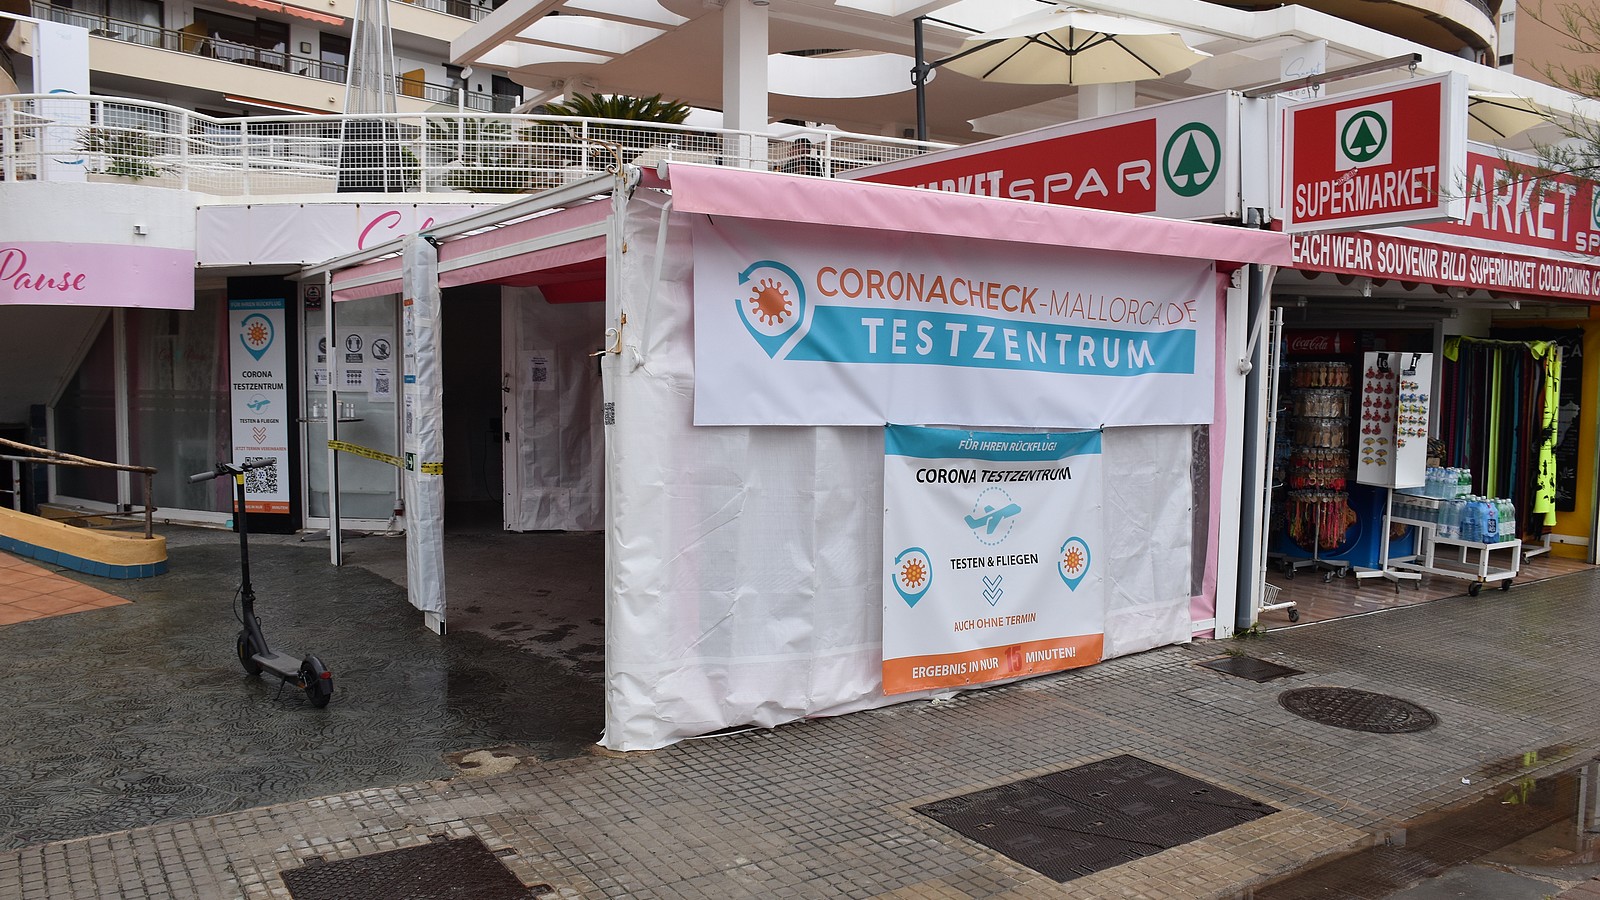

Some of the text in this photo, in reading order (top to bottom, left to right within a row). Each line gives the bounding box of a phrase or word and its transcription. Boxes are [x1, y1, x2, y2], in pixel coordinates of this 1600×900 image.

[1008, 159, 1151, 203] SPAR
[1295, 165, 1436, 219] SUPERMARKET
[1463, 164, 1577, 242] ARKET
[1575, 231, 1600, 252] SP
[0, 248, 86, 291] Pause
[1291, 234, 1330, 266] EACH
[1332, 236, 1373, 270] WEAR
[1377, 241, 1438, 279] SOUVENIR
[1441, 251, 1466, 282] BILD
[1469, 255, 1536, 289] SUPERMARKET
[816, 266, 1197, 326] CORONACHECK-MALLORCA.DE
[861, 317, 1156, 370] TESTZENTRUM
[233, 383, 284, 391] TESTZENTRUM
[242, 370, 273, 378] CORONA
[958, 438, 1057, 452] FÜR IHREN RÜCKFLUG!
[915, 466, 1071, 484] CORONA TESTZENTRUM
[950, 553, 1039, 570] TESTEN & FLIEGEN
[954, 612, 1036, 632] AUCH OHNE TERMIN
[912, 645, 1076, 679] ERGEBNIS IN NUR 15 MINUTEN!
